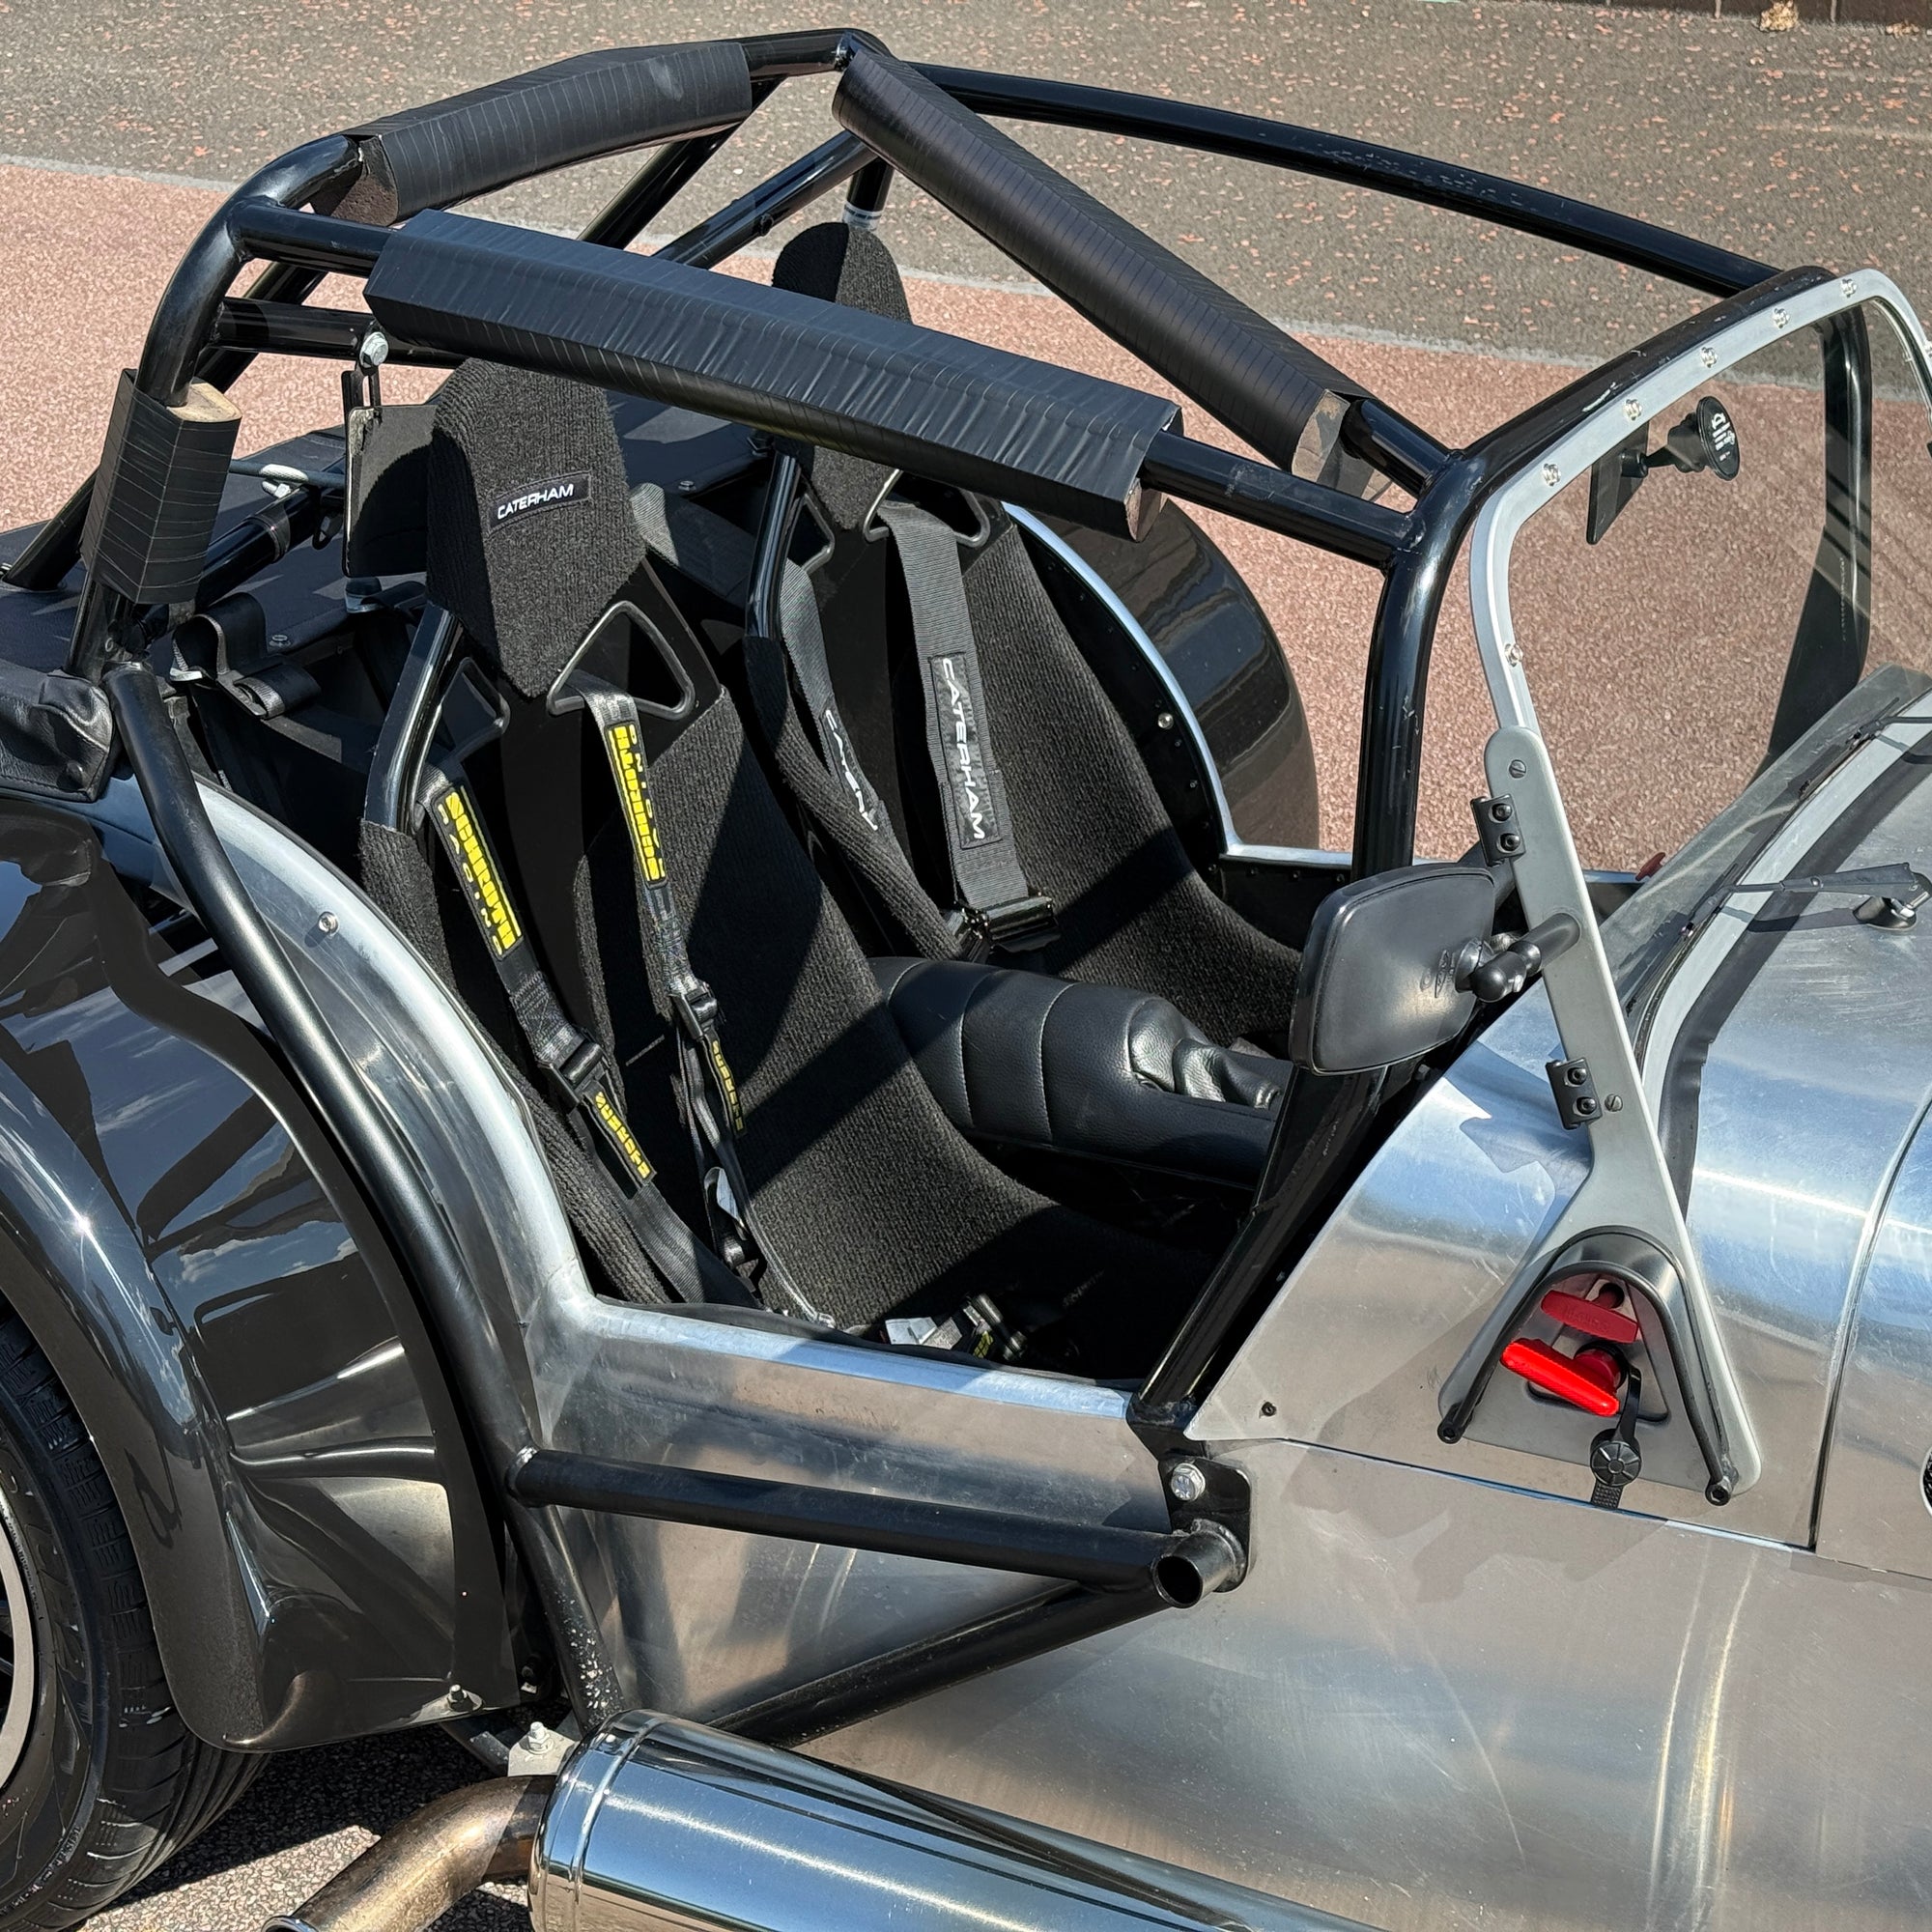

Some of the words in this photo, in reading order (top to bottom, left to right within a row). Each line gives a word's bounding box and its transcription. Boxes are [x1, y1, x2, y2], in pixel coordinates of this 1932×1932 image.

[497, 483, 575, 520] CATERHAM
[614, 726, 660, 880] SCHROTH
[629, 724, 667, 878] RACING
[942, 657, 986, 839] CATERHAM
[437, 803, 503, 955] RACING
[445, 791, 517, 950] SCHROTH
